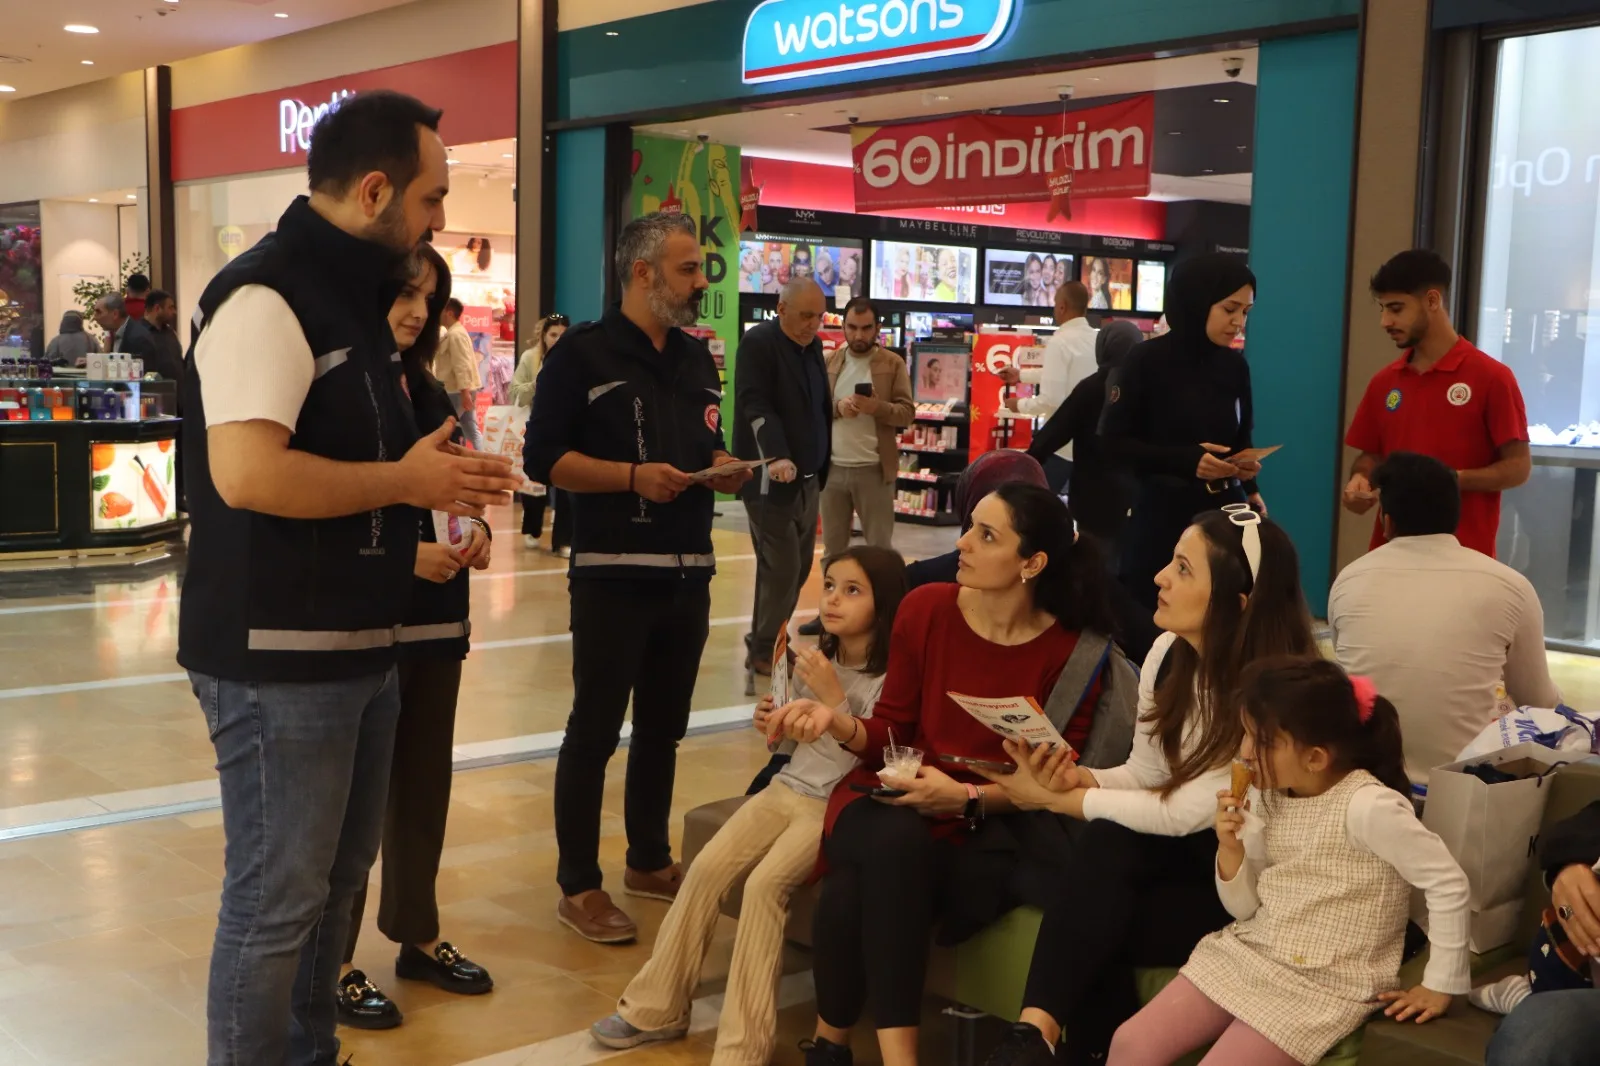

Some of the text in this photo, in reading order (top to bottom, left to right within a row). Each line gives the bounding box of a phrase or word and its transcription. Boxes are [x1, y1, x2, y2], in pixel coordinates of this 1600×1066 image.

[774, 0, 964, 55] watsons
[900, 219, 978, 234] MAYBELLINE
[1016, 229, 1062, 241] REVOLUTION
[463, 314, 490, 328] Penti
